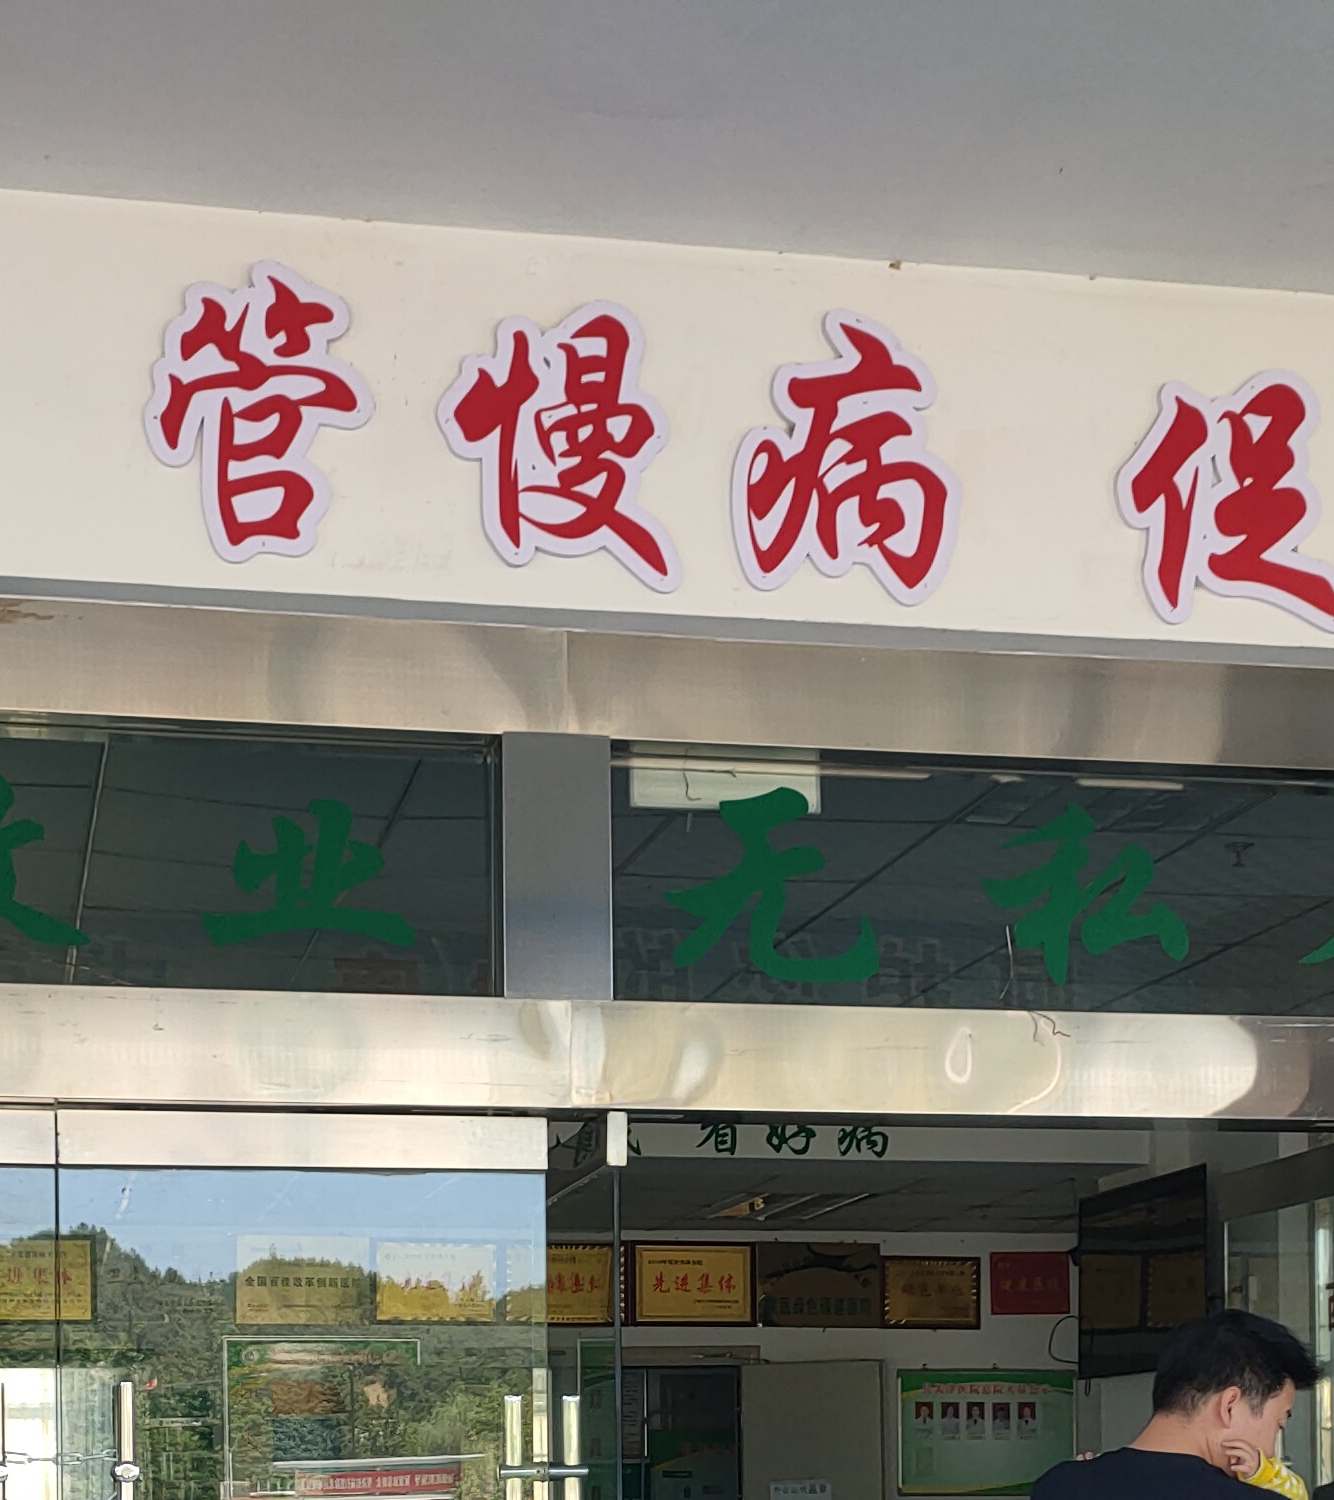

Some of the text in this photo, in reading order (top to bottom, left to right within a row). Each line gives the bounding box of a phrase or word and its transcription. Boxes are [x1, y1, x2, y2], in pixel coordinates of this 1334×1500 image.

[162, 275, 947, 589] 管慢病
[652, 1270, 736, 1294] 先进集体
